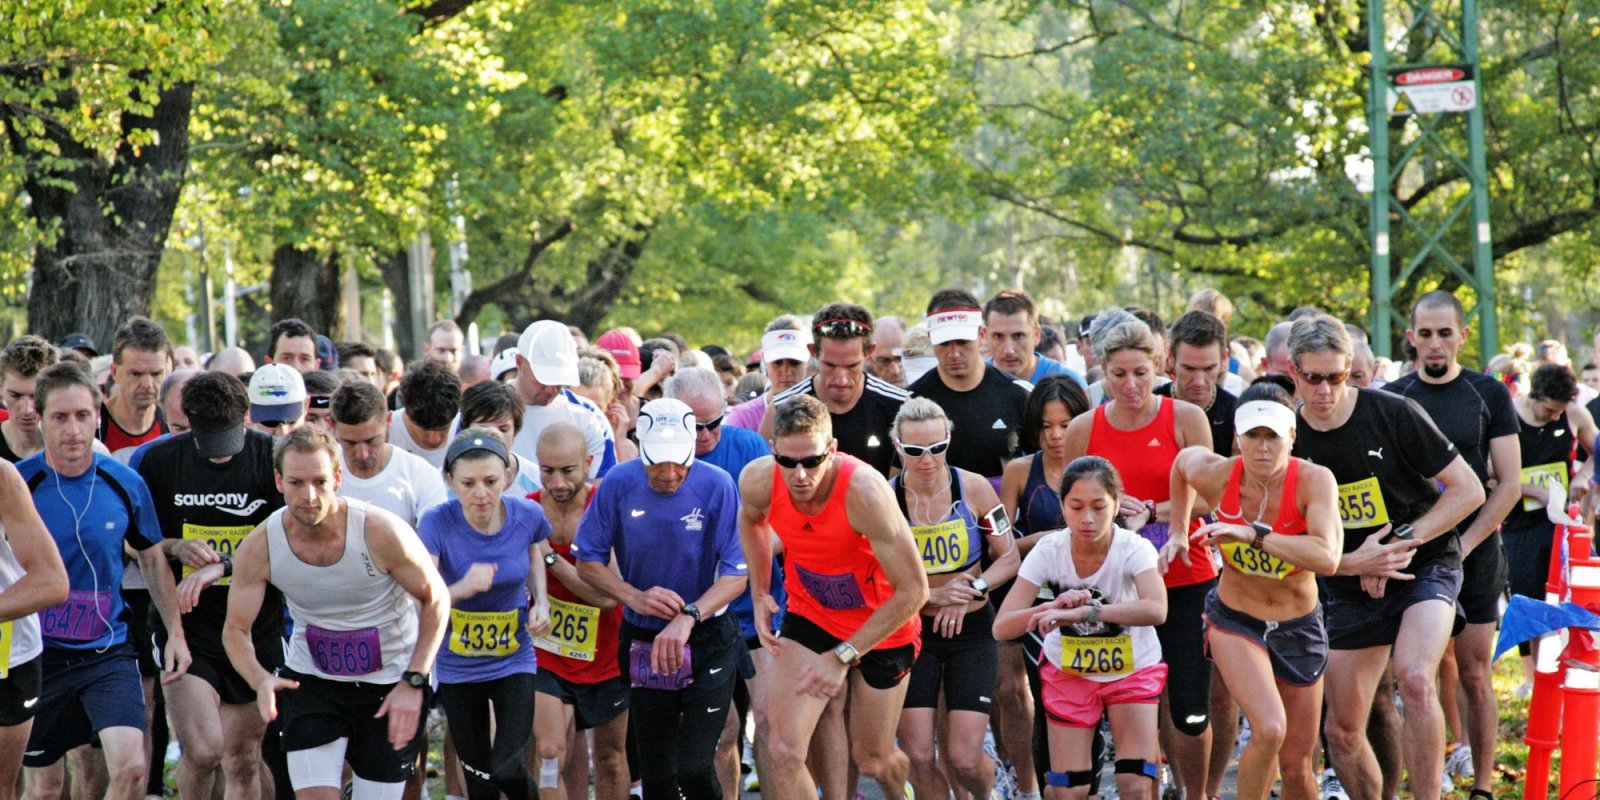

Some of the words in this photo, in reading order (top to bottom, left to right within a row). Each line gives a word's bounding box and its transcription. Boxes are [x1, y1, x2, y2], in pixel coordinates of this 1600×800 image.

[1406, 70, 1452, 82] DANGER
[174, 493, 248, 508] saucony
[199, 528, 228, 536] CHINMOY
[44, 601, 98, 637] 6471
[549, 609, 589, 644] 265
[459, 622, 511, 650] 4334
[316, 639, 372, 673] 6569
[568, 650, 589, 659] 4265
[1071, 646, 1125, 673] 4266
